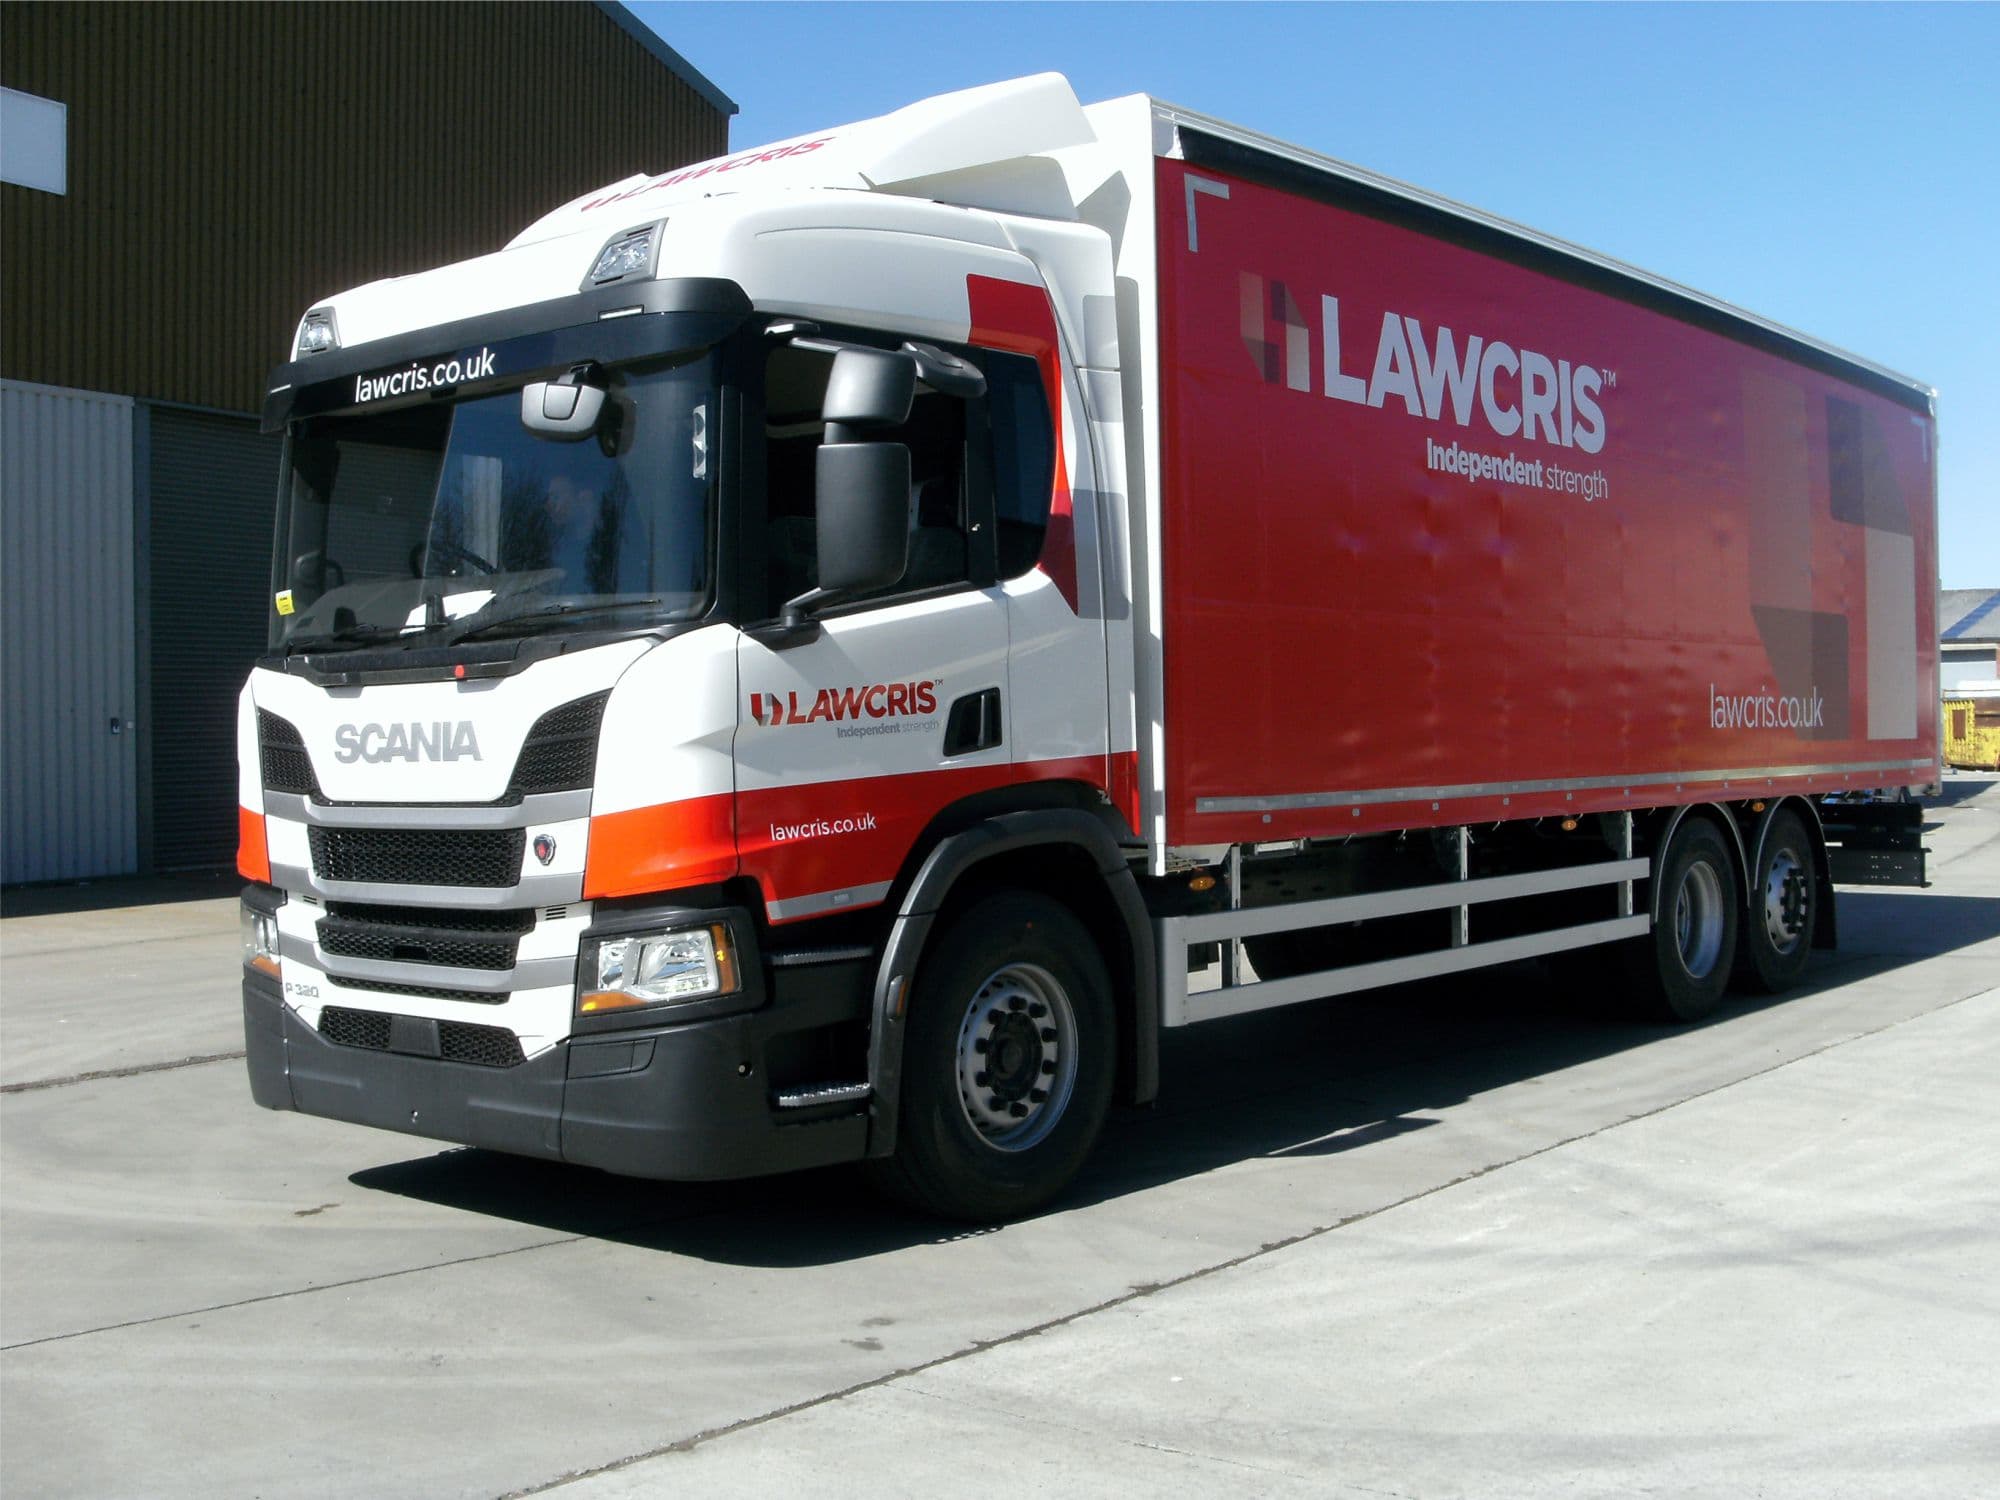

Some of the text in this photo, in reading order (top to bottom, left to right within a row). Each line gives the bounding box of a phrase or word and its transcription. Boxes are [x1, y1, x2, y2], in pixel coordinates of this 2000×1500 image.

[354, 347, 496, 403] lawcris.co.uk
[1321, 294, 1606, 455] LAWCRIS
[1427, 437, 1609, 502] Independent strength
[1710, 683, 1824, 728] lawcris.co.uk
[334, 720, 484, 764] SCANIA
[837, 719, 940, 739] Independent strength
[770, 812, 877, 841] lawcris.co.uk
